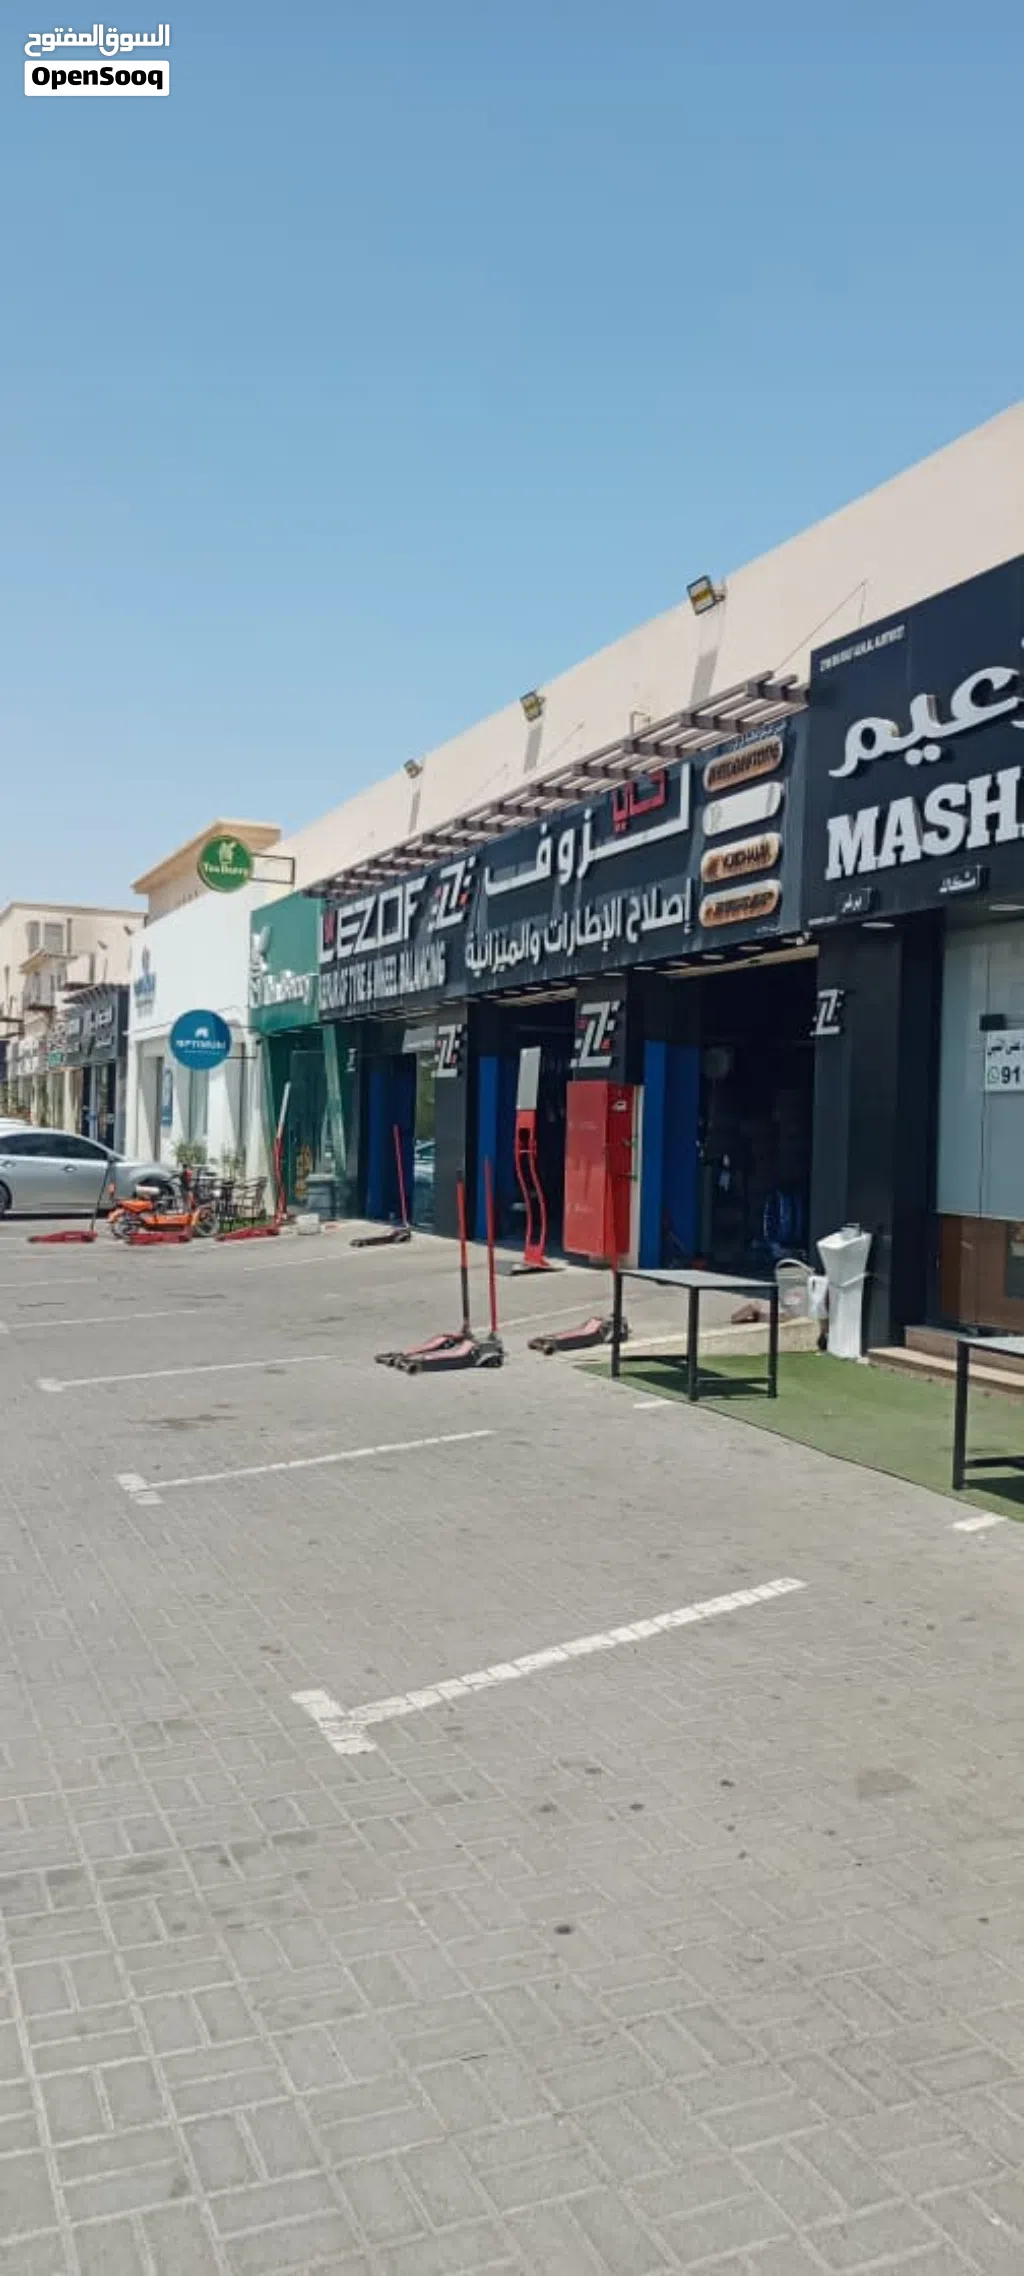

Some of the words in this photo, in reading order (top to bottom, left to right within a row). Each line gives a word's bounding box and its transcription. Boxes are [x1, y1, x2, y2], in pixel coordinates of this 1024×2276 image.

[829, 660, 1024, 778] عيم
[824, 763, 1024, 883] MASH
[543, 895, 622, 957] الإطارات
[626, 876, 692, 943] إصلاح
